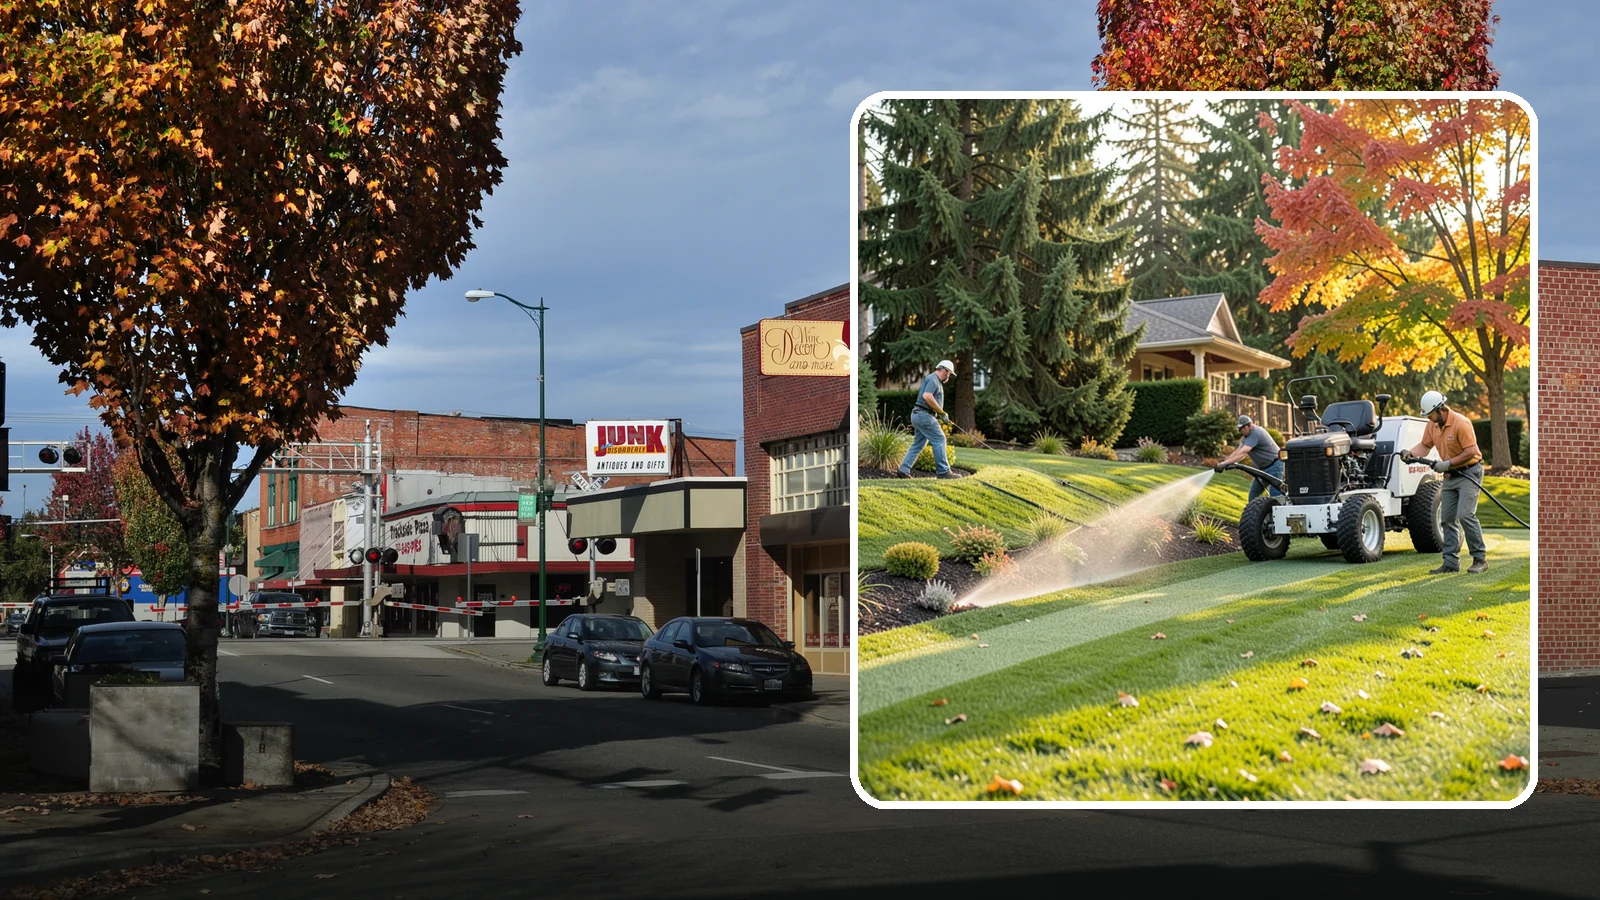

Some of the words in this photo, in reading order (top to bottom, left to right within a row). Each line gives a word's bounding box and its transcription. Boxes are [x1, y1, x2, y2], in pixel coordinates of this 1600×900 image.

[596, 425, 664, 457] JUNK
[607, 446, 645, 454] DISORDERLY
[597, 461, 628, 470] ANTIQUES
[631, 461, 643, 470] AND
[647, 460, 665, 469] GIFTS
[414, 519, 429, 535] Pizza
